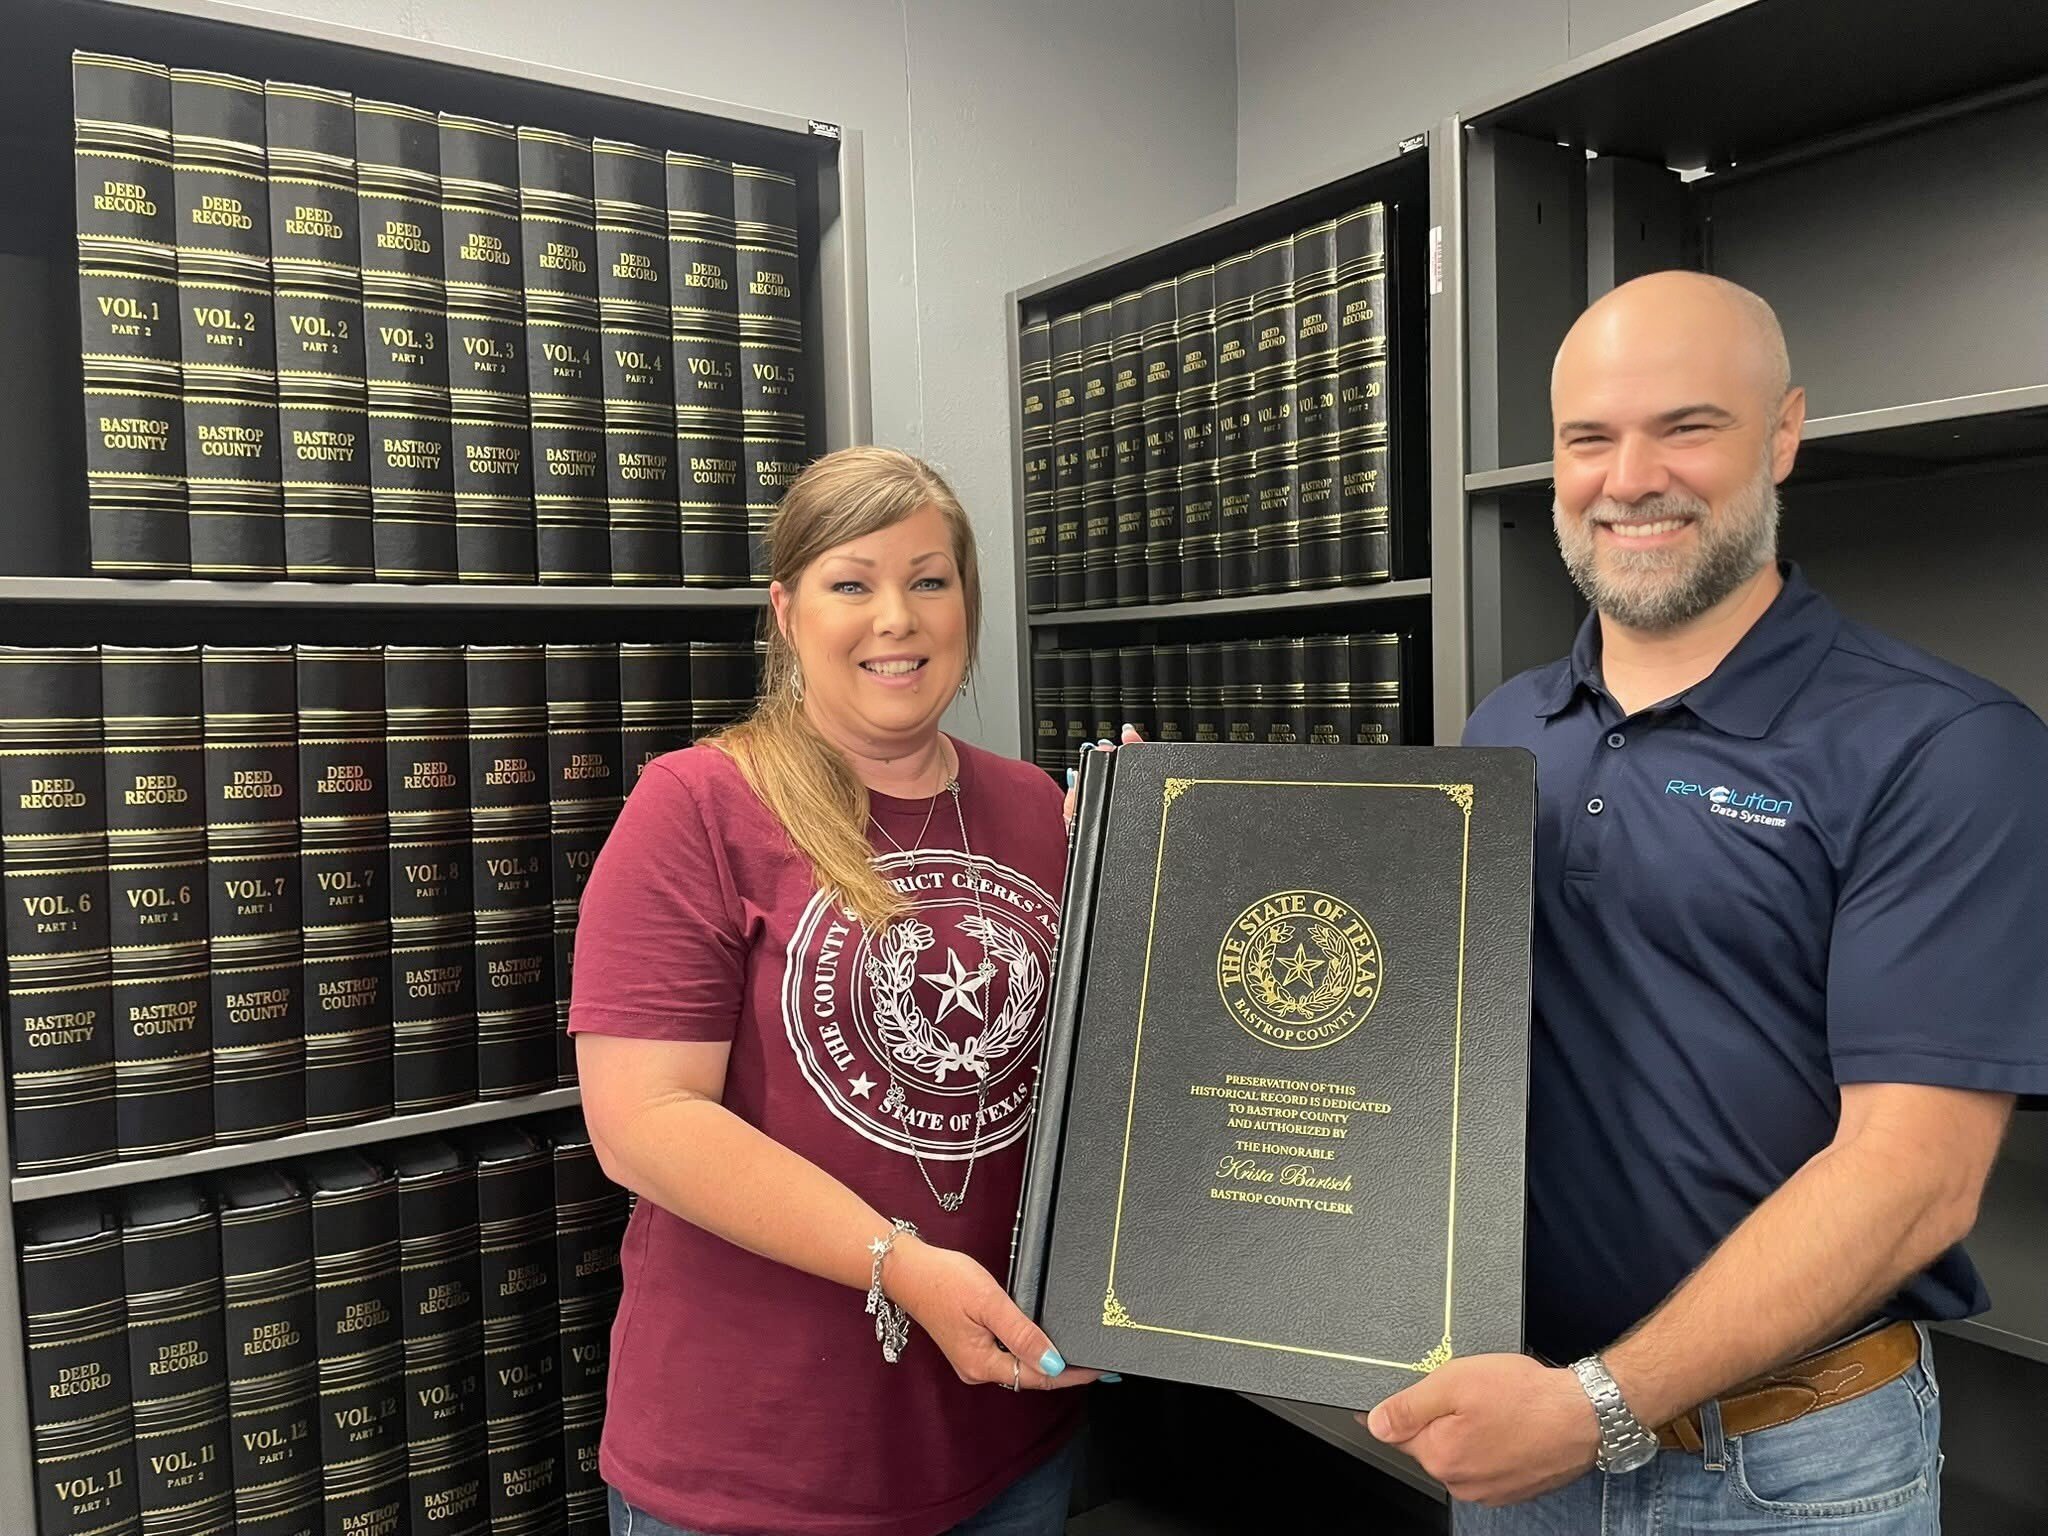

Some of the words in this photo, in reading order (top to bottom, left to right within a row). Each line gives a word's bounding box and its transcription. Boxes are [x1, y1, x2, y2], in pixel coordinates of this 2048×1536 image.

[104, 182, 146, 199] DEED
[94, 196, 156, 216] RECORD
[202, 197, 241, 213] DEED
[192, 210, 252, 229] RECORD
[295, 207, 332, 223] DEED
[285, 220, 342, 239] RECORD
[386, 222, 421, 238] DEED
[377, 235, 431, 253] RECORD
[469, 234, 502, 250] DEED
[460, 246, 510, 265] RECORD
[547, 243, 578, 258] DEED
[540, 255, 586, 273] RECORD
[620, 253, 650, 268] DEED
[612, 265, 657, 282] RECORD
[692, 263, 720, 278] DEED
[685, 274, 728, 291] RECORD
[757, 272, 783, 286] DEED
[749, 283, 790, 298] RECORD
[98, 298, 148, 320] VOL.
[151, 302, 159, 320] 1
[1346, 300, 1366, 313] DEED
[194, 308, 241, 330] VOL.
[244, 314, 255, 331] 2
[1303, 314, 1322, 327] DEED
[1343, 310, 1373, 326] RECORD
[112, 324, 141, 335] PART
[145, 327, 151, 336] 2
[290, 316, 335, 338] VOL.
[338, 321, 348, 338] 2
[1300, 322, 1328, 338] RECORD
[207, 334, 234, 345] PART
[238, 337, 242, 346] 1
[380, 328, 422, 349] VOL.
[424, 333, 434, 349] 3
[303, 342, 330, 352] PART
[332, 344, 338, 353] 2
[464, 338, 503, 358] VOL.
[506, 343, 514, 359] 3
[543, 344, 580, 364] VOL.
[582, 349, 591, 365] 4
[392, 353, 417, 363] PART
[420, 355, 424, 364] 1
[615, 351, 652, 370] VOL.
[654, 357, 662, 371] 4
[688, 358, 722, 376] VOL.
[724, 363, 732, 377] 5
[752, 364, 785, 381] VOL.
[787, 369, 794, 382] 5
[1342, 386, 1363, 402] VOL.
[1366, 382, 1380, 398] 20
[100, 418, 168, 434] BASTROP
[198, 426, 263, 442] BASTROP
[104, 434, 168, 450] COUNTY
[293, 432, 355, 447] BASTROP
[384, 440, 441, 455] BASTROP
[202, 442, 262, 458] COUNTY
[297, 446, 354, 461] COUNTY
[466, 446, 520, 460] BASTROP
[546, 448, 596, 462] BASTROP
[387, 454, 440, 469] COUNTY
[469, 460, 519, 474] COUNTY
[618, 454, 667, 467] BASTROP
[691, 458, 736, 471] BASTROP
[757, 461, 800, 473] BASTROP
[550, 462, 596, 476] COUNTY
[621, 466, 667, 480] COUNTY
[693, 471, 736, 484] COUNTY
[1302, 478, 1332, 492] BASTROP
[1344, 470, 1377, 485] BASTROP
[1303, 489, 1331, 503] COUNTY
[1345, 482, 1376, 496] COUNTY
[135, 776, 177, 790] DEED
[234, 771, 273, 785] DEED
[31, 779, 74, 794] DEED
[224, 784, 282, 799] RECORD
[20, 793, 86, 809] RECORD
[125, 789, 188, 805] RECORD
[1665, 780, 1792, 814] Revolution
[1710, 803, 1737, 818] Data
[1740, 810, 1786, 827] Systems
[225, 881, 271, 899] VOL.
[274, 879, 285, 895] 7
[23, 897, 74, 916] VOL.
[79, 895, 91, 911] 6
[127, 889, 176, 908] VOL.
[179, 887, 190, 903] 6
[238, 905, 265, 914] PART
[269, 904, 273, 912] 1
[842, 907, 858, 922] &
[140, 914, 169, 925] PART
[173, 913, 178, 921] 2
[37, 923, 66, 933] PART
[72, 922, 77, 930] 1
[1222, 938, 1245, 988] THE
[1238, 895, 1306, 935] STATE
[1313, 899, 1347, 922] OF
[1343, 919, 1376, 999] TEXAS
[814, 920, 850, 1017] COUNTY
[227, 989, 289, 1007] BASTROP
[130, 1001, 198, 1020] BASTROP
[230, 1003, 288, 1023] COUNTY
[24, 1011, 95, 1031] BASTROP
[134, 1017, 196, 1036] COUNTY
[1234, 998, 1294, 1041] BASTROP
[1296, 1006, 1356, 1041] COUNTY
[29, 1028, 94, 1047] COUNTY
[819, 1021, 855, 1072] THE
[1226, 1075, 1309, 1092] PRESERVATION
[1311, 1083, 1326, 1092] OF
[1325, 1084, 1356, 1095] THIS
[878, 1097, 943, 1131] STATE
[949, 1114, 972, 1132] OF
[979, 1082, 1028, 1126] TEXAS
[1191, 1086, 1258, 1102] HISTORICAL
[1260, 1093, 1308, 1105] RECORD
[1310, 1097, 1320, 1106] IS
[1322, 1098, 1391, 1114] DEDICATED
[1228, 1104, 1245, 1114] TO
[1247, 1106, 1298, 1119] BASTROP
[1300, 1110, 1349, 1124] COUNTY
[1227, 1119, 1252, 1129] AND
[1254, 1122, 1331, 1137] AUTHORIZED
[1333, 1129, 1348, 1139] BY
[1236, 1141, 1260, 1152] THE
[1262, 1143, 1335, 1160] HONORABLE
[1216, 1155, 1274, 1183] Krista
[1279, 1164, 1353, 1192] Bartsch
[1211, 1189, 1262, 1203] BASTROP
[1264, 1195, 1315, 1209] COUNTY
[1314, 1201, 1353, 1214] CLERK
[159, 1341, 198, 1360] DEED
[150, 1352, 208, 1375] RECORD
[59, 1363, 100, 1383] DEED
[50, 1374, 111, 1399] RECORD
[151, 1455, 197, 1474] VOL.
[201, 1445, 214, 1463] 11
[56, 1479, 104, 1501] VOL.
[108, 1468, 122, 1488] 11
[167, 1475, 193, 1488] PART
[73, 1500, 102, 1514] PART
